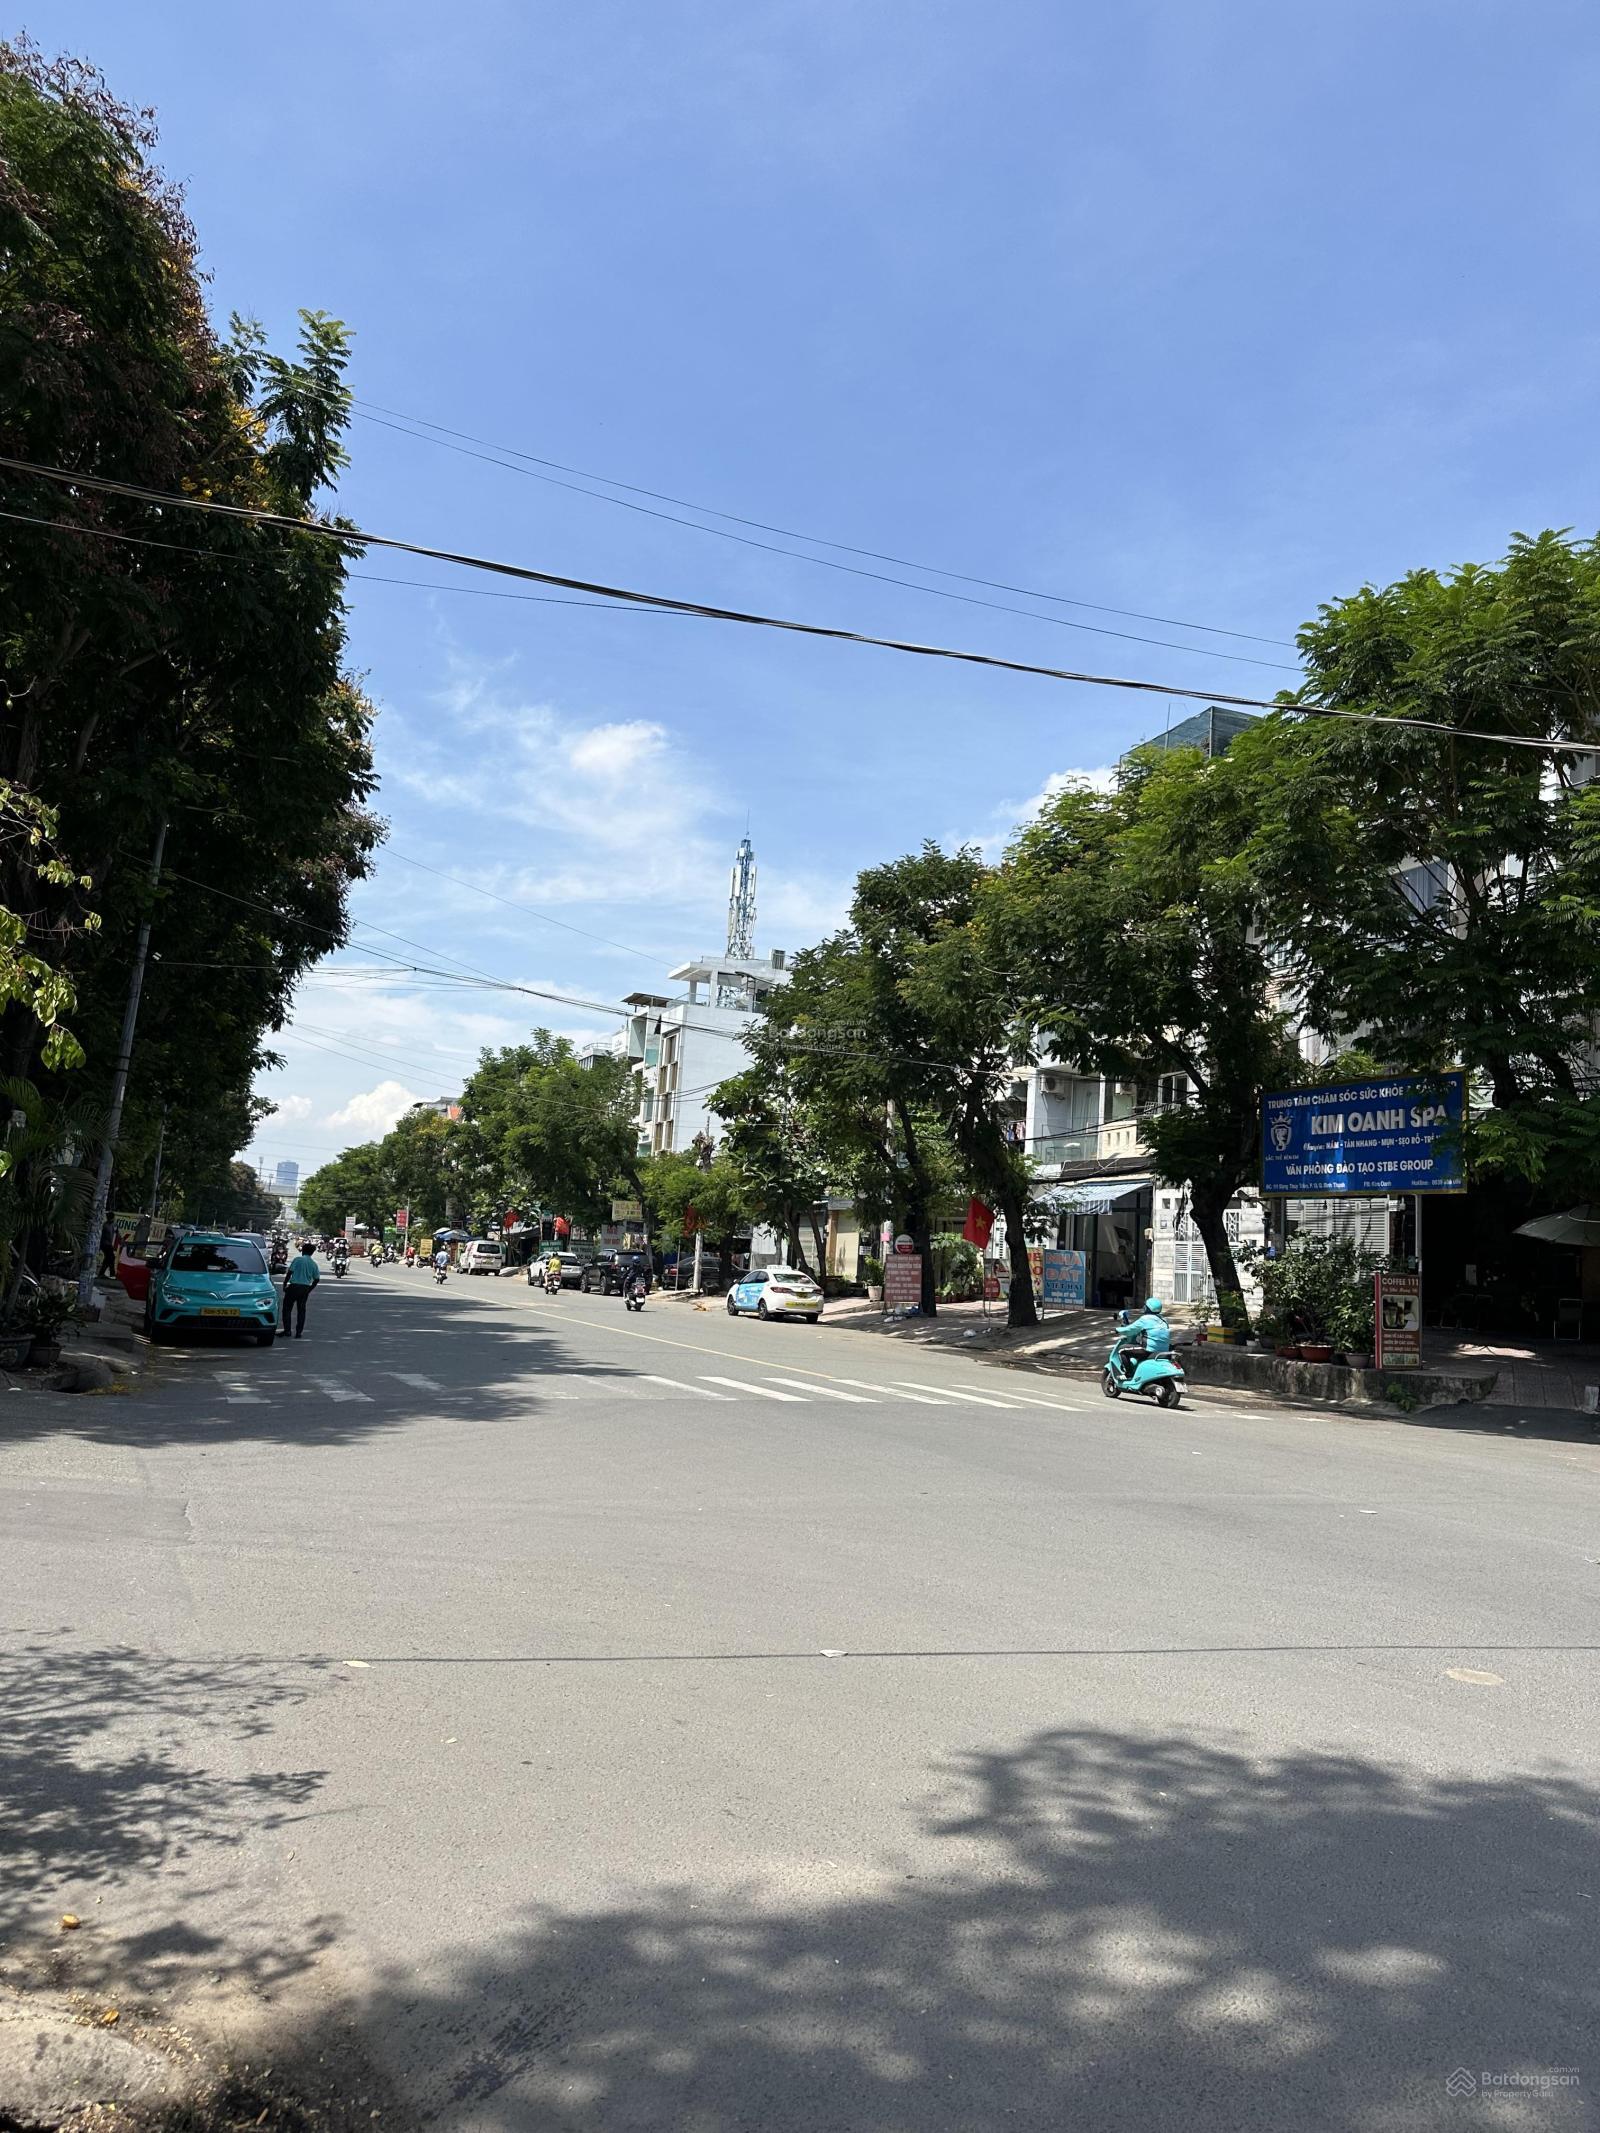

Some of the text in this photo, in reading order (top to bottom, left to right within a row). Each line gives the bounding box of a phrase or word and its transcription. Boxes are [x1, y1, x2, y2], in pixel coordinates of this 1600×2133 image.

[1268, 1098, 1293, 1110] TRUNG
[1293, 1094, 1311, 1106] TÂM
[1312, 1092, 1337, 1104] CHĂM
[1338, 1089, 1358, 1102] SÓC
[1359, 1086, 1378, 1100] SỨC
[1311, 1105, 1449, 1135] KIM OANH SPA
[1285, 1159, 1434, 1176] VĂN PHÒNG ĐÀO TẠO STBE GROUP
[1046, 1266, 1082, 1282] ĐẤT
[1382, 1277, 1419, 1286] COFFEE 111
